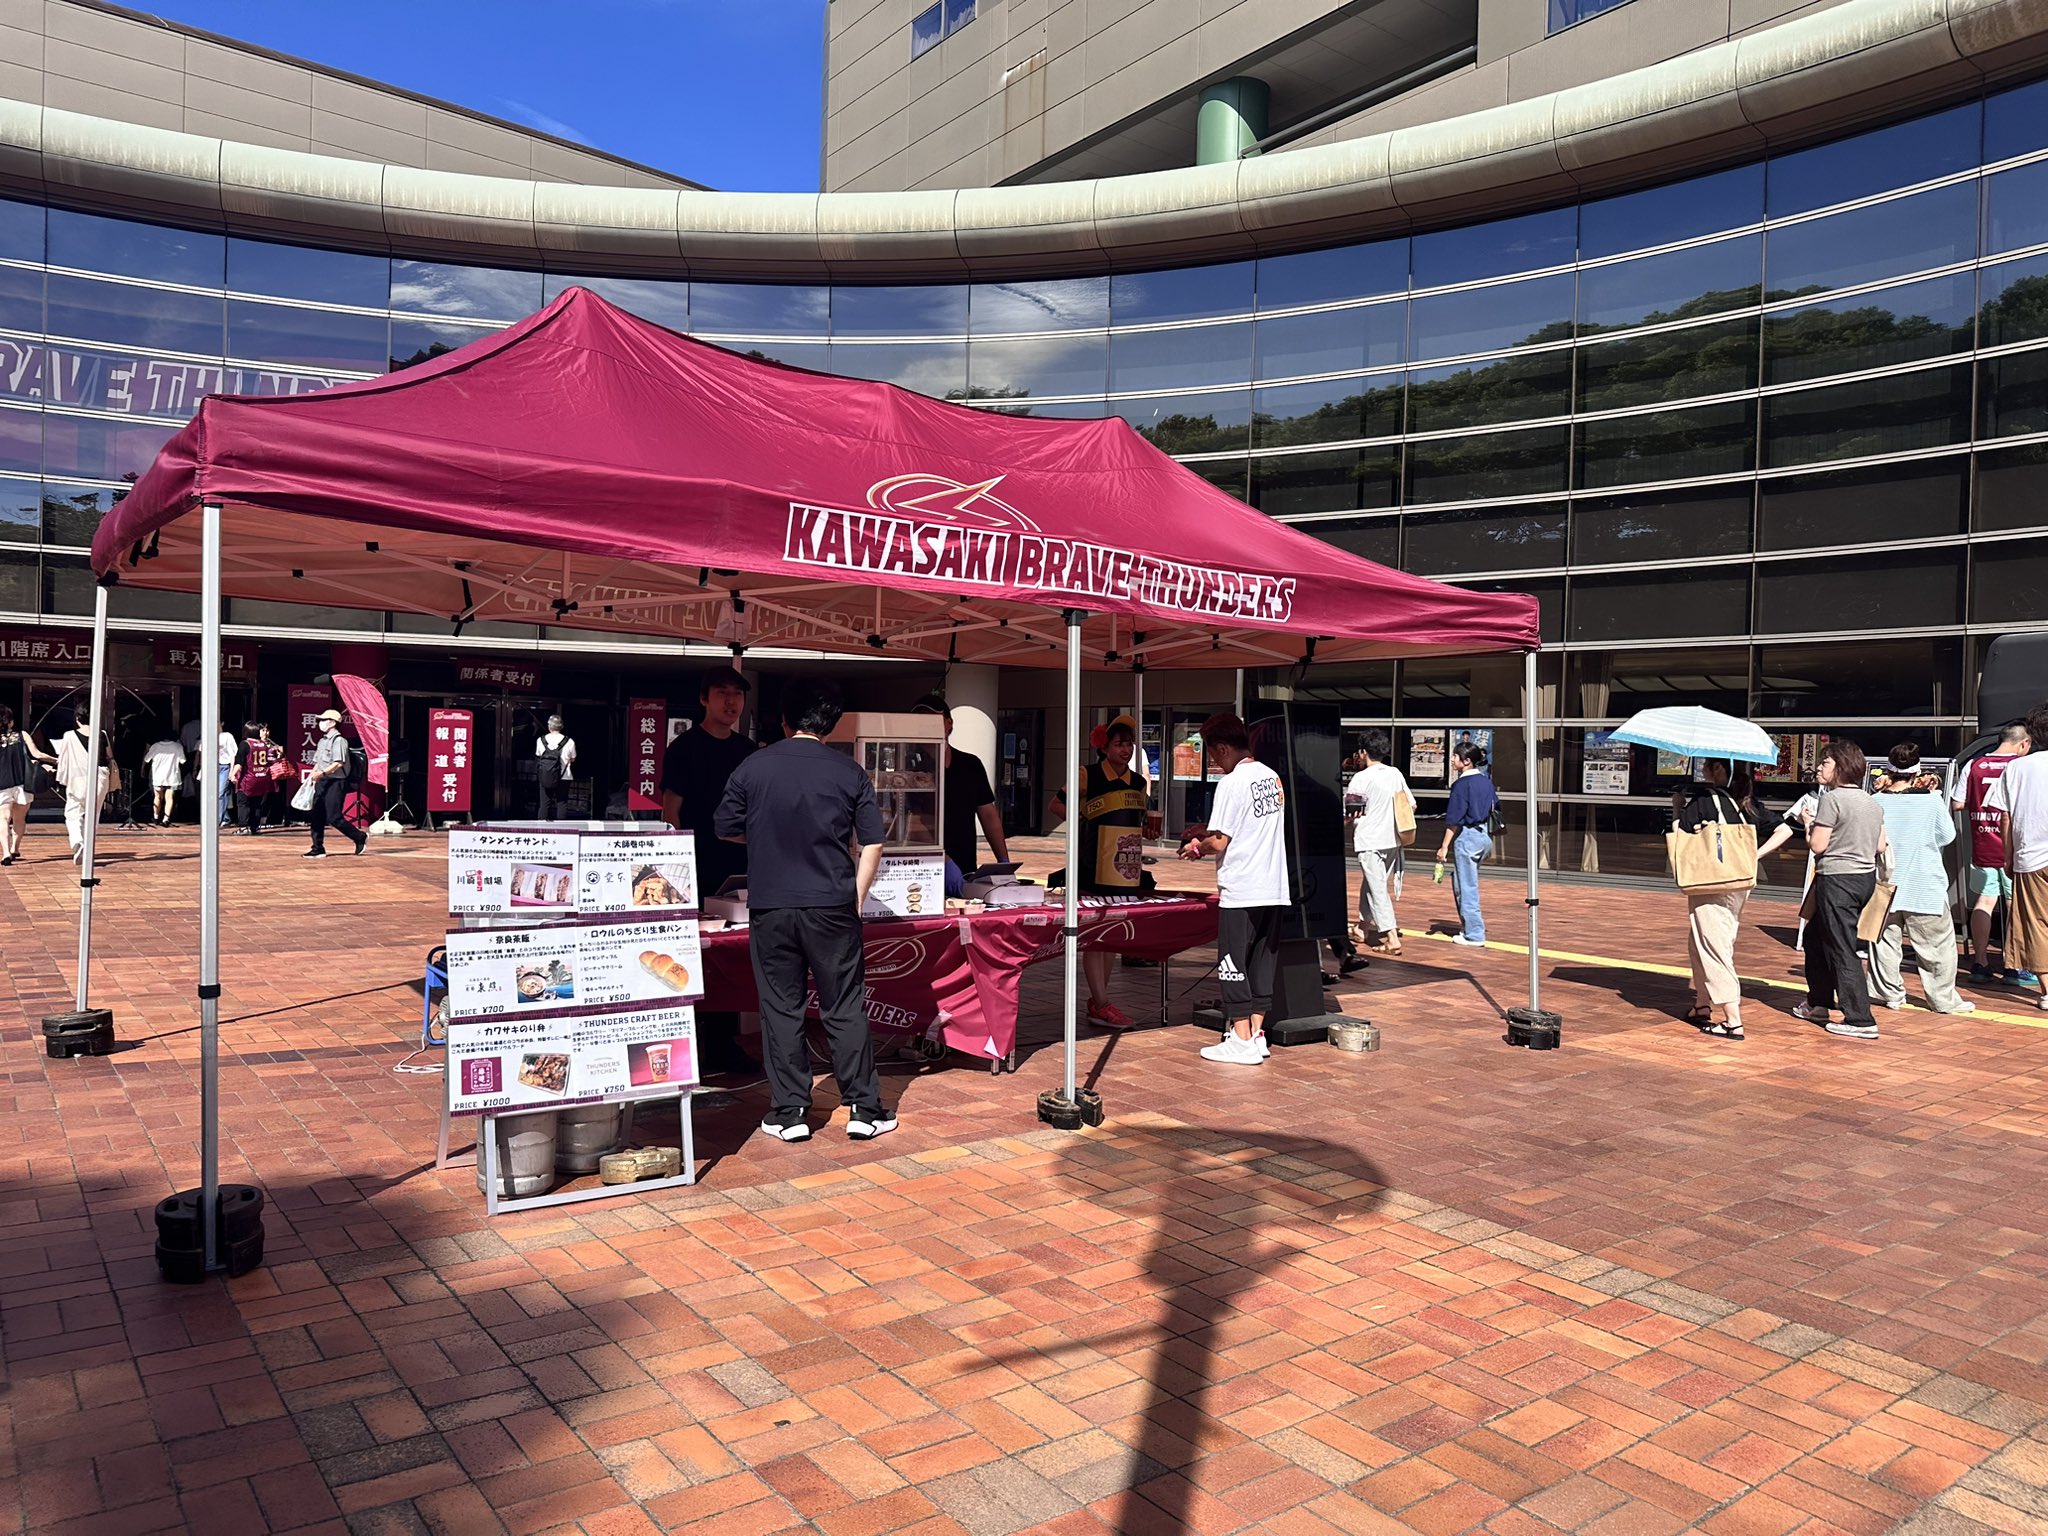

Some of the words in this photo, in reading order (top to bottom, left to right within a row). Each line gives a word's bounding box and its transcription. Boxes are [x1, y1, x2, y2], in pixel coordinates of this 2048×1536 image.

[783, 503, 1010, 586] KAWASAKI
[1014, 535, 1133, 599] BRAVE
[1135, 554, 1296, 623] THUNDERS
[460, 667, 536, 687] 関係者受付
[435, 726, 449, 768] 報道
[453, 727, 468, 768] 関係者
[252, 750, 268, 766] 18
[640, 717, 656, 796] 総合案内
[442, 773, 457, 803] 受付
[1980, 777, 2000, 807] 7
[480, 835, 549, 846] タンメンチサンド
[480, 904, 502, 912] ¥900
[605, 904, 626, 912] ¥400
[495, 934, 530, 944] 奈良茶飯
[609, 993, 631, 1001] ¥500
[455, 1008, 477, 1016] PRICE
[482, 1005, 504, 1014] ¥700
[584, 1017, 629, 1028] THUNDERS
[631, 1014, 656, 1023] CRAFT
[658, 1012, 680, 1021] BEER
[484, 1024, 545, 1036] カワサキのり弁
[578, 1089, 600, 1097] PRICE
[604, 1085, 625, 1094] ¥750
[454, 1101, 477, 1110] PRICE
[483, 1097, 511, 1107] ¥1000
